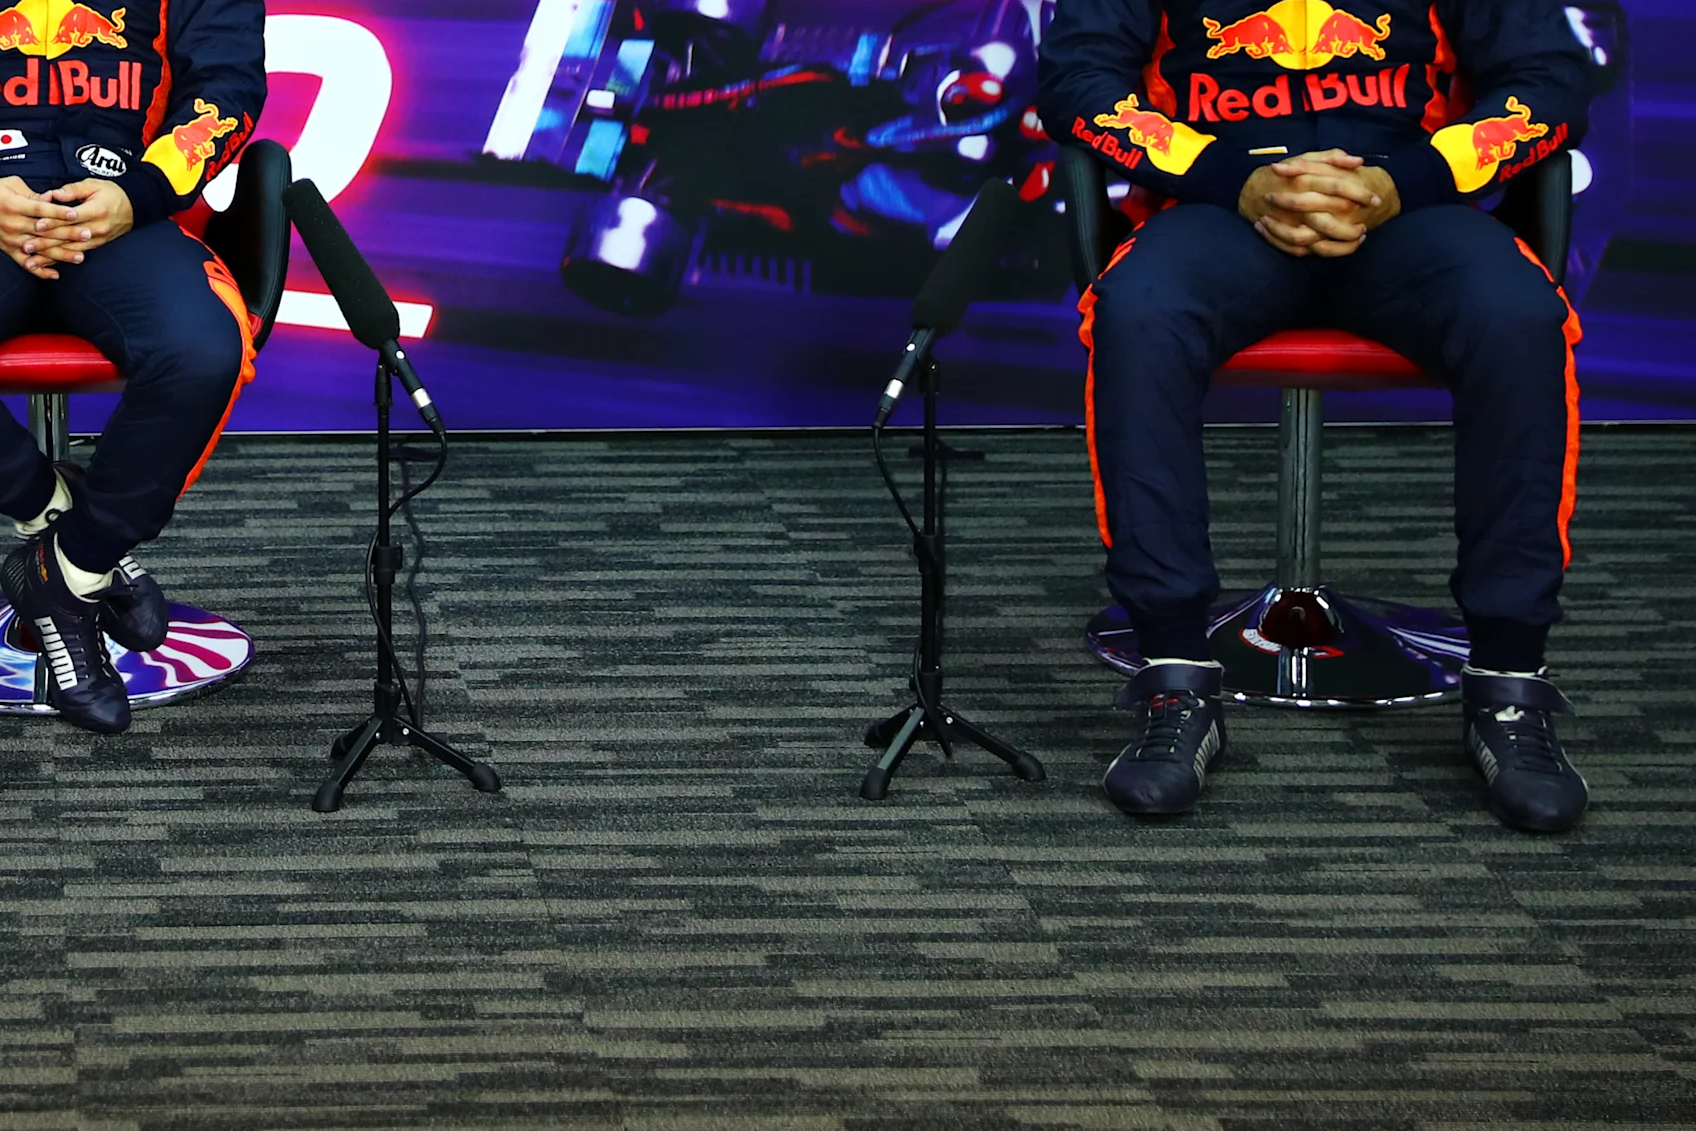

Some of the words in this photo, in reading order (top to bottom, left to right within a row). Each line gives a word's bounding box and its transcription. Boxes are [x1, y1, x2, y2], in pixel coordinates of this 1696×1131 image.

[49, 60, 142, 111] Bull
[1187, 73, 1293, 123] Red
[1302, 63, 1411, 113] Bull
[77, 145, 125, 173] Arai
